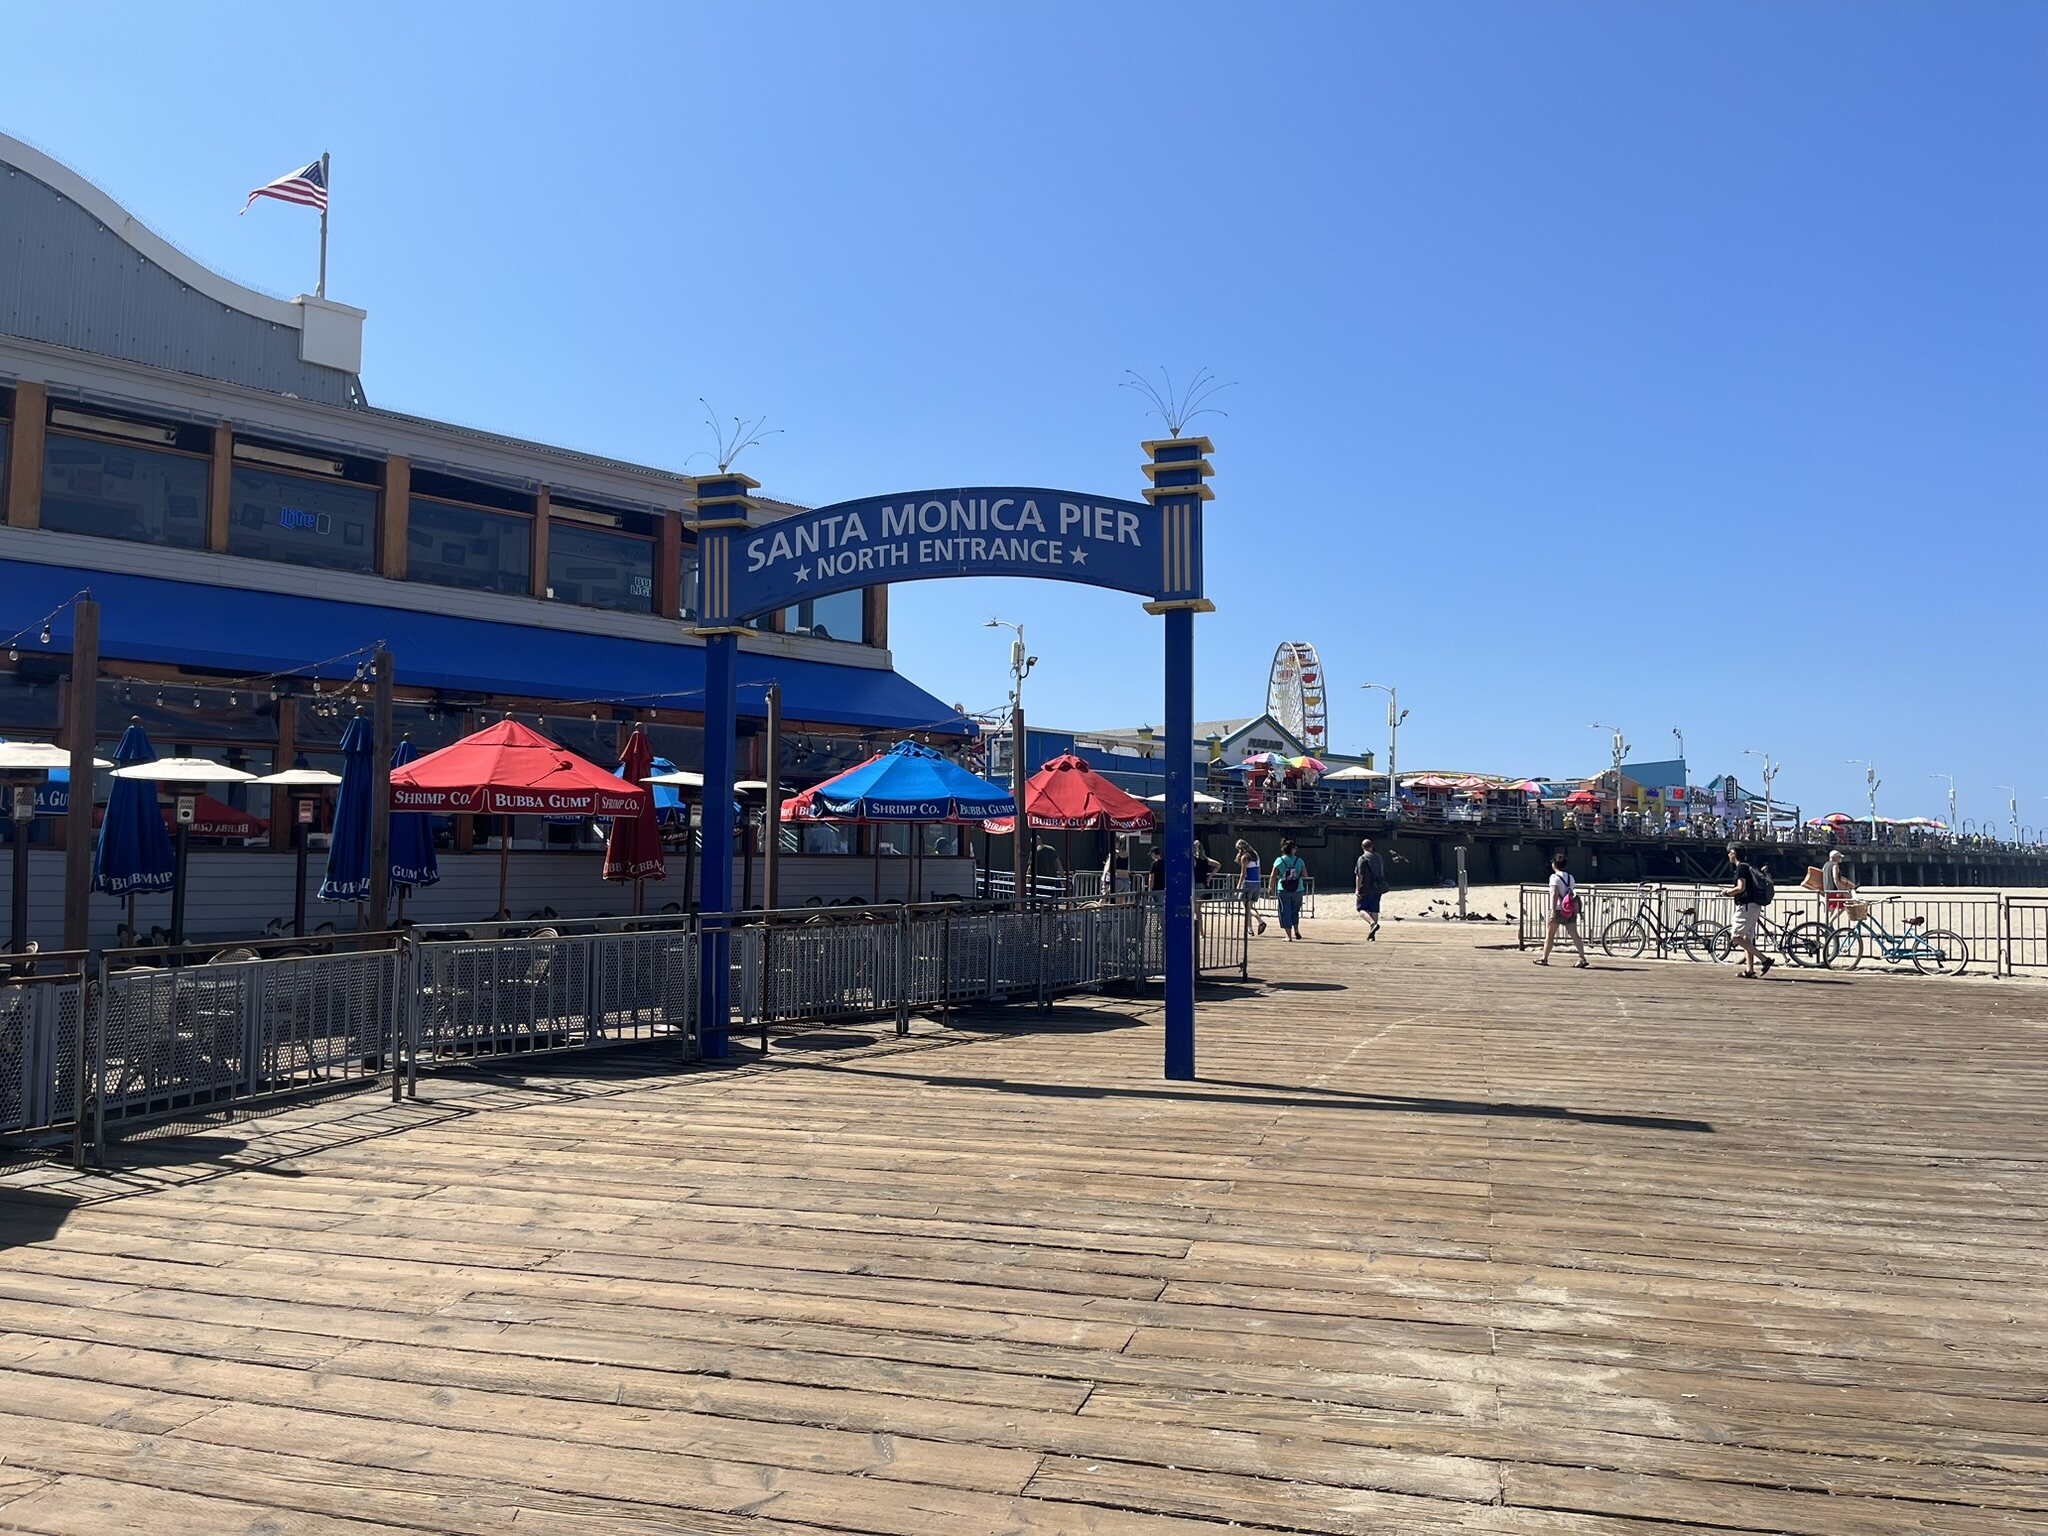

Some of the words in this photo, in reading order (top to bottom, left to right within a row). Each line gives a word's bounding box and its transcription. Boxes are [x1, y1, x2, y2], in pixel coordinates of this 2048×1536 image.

[280, 506, 316, 529] Lite
[747, 512, 868, 572] SANTA
[881, 499, 1046, 538] MONICA
[1059, 502, 1141, 547] PIER
[817, 542, 909, 580] NORTH
[919, 537, 1063, 564] ENTRANCE
[395, 790, 446, 805] SHRIMP
[450, 791, 472, 805] CO.
[495, 793, 545, 808] BUBBA
[548, 794, 591, 808] GUMP
[601, 796, 624, 809] SHRIMP
[624, 797, 640, 811] CO.
[872, 803, 917, 814] SHRIMP
[919, 803, 940, 815] CO.
[959, 803, 987, 815] BUBBA
[988, 804, 1015, 815] GUMP
[1031, 816, 1066, 827] BUBBA
[1068, 816, 1097, 827] GUMP
